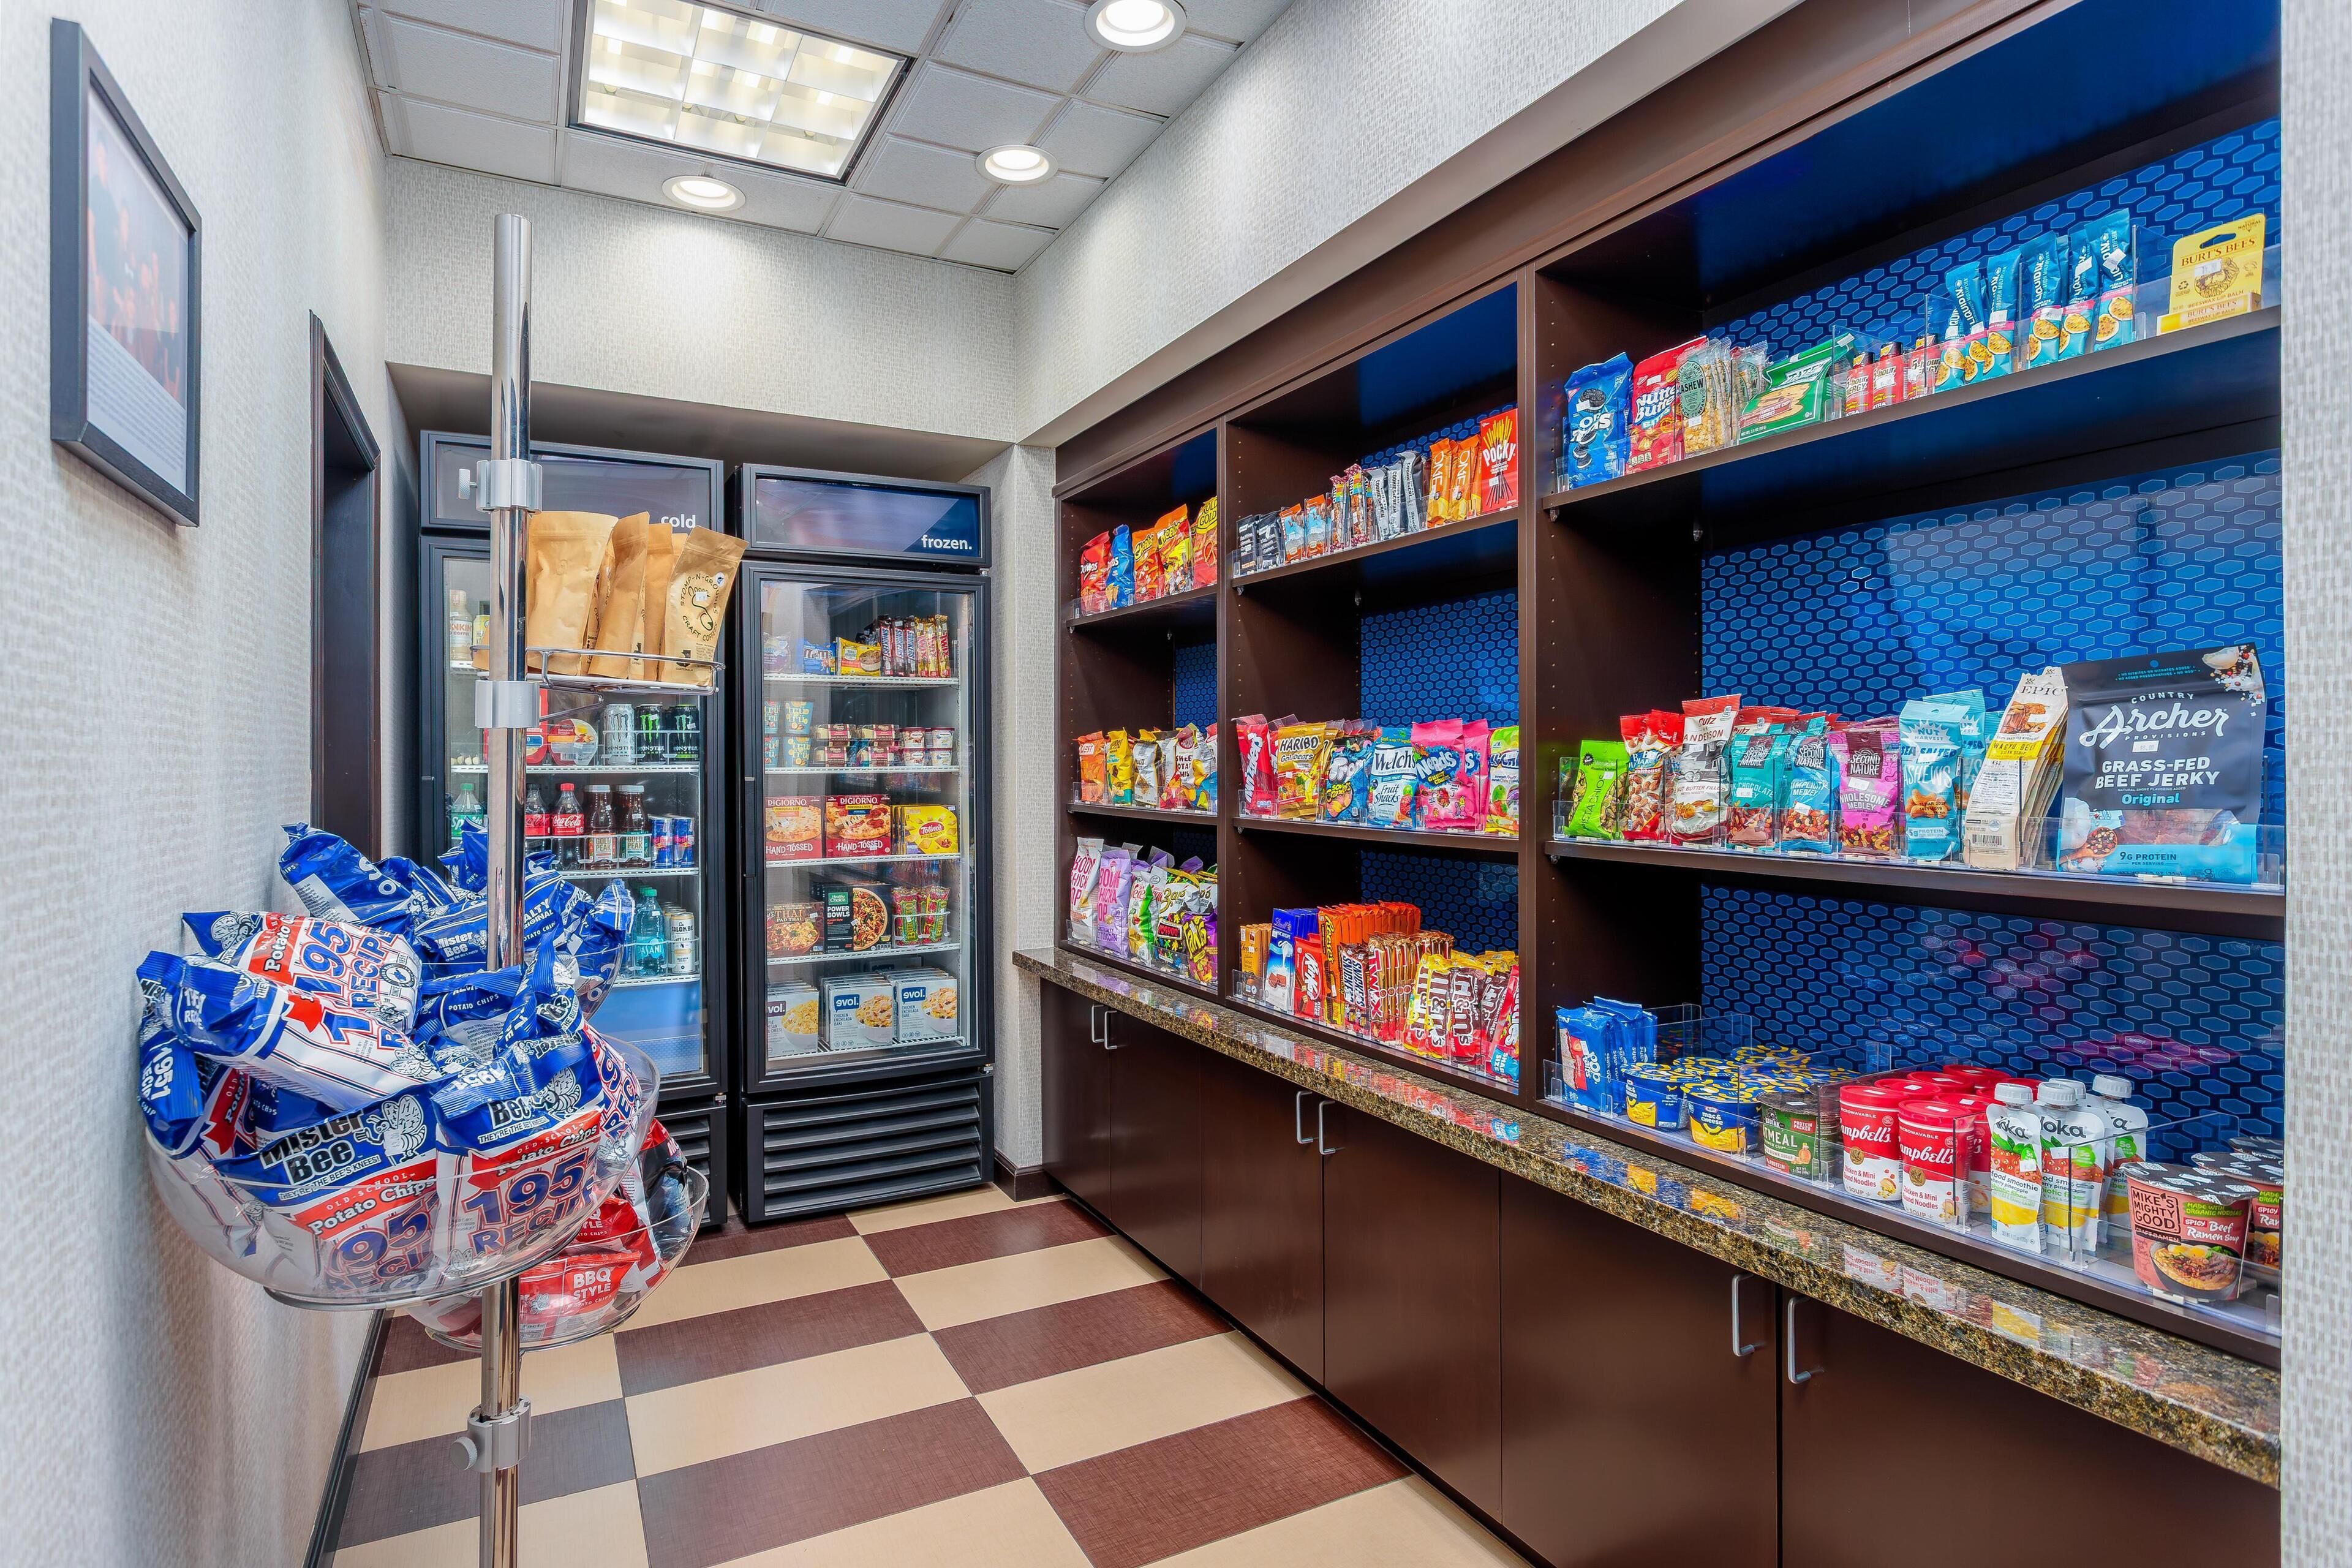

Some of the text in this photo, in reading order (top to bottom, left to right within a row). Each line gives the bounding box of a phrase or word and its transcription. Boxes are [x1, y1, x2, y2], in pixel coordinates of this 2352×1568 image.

[2237, 220, 2261, 230] NATURAL
[2180, 238, 2256, 267] BURT'S BEES
[2188, 298, 2215, 309] BEESWAX
[2227, 290, 2244, 298] BALM
[2187, 300, 2237, 318] BURT'S BEES
[2187, 315, 2212, 323] BEESWAX
[1761, 404, 1781, 415] CHOCOLATE
[1761, 410, 1776, 419] COOKIES
[1482, 439, 1517, 467] POCKY
[1431, 450, 1444, 486] ONE
[1456, 450, 1471, 486] ONE
[661, 514, 696, 529] cold
[1199, 510, 1217, 526] GOLD
[921, 535, 972, 551] frozen.
[682, 615, 701, 639] CRAFT
[881, 627, 891, 657] SNICKERS
[894, 627, 903, 658] SNICKERS
[906, 628, 914, 660] SNICKERS
[2021, 685, 2065, 696] EPIC
[2131, 692, 2195, 704] COUNTRY
[1918, 727, 1940, 736] NUT
[2079, 702, 2230, 749] Archer
[1684, 729, 1724, 741] ANDERSON
[2125, 730, 2206, 741] PROVISIONS
[1280, 735, 1321, 753] HARIBO
[1901, 745, 1958, 758] SEA SALTED
[1374, 749, 1416, 771] Welch's
[1740, 756, 1763, 766] NATURE
[1746, 749, 1769, 759] SECOND
[1798, 747, 1824, 759] SECOND
[1850, 754, 1880, 765] SECOND
[1796, 758, 1824, 769] NATURE
[1850, 764, 1880, 775] NATURE
[2101, 756, 2211, 774] GRASS-FED
[1904, 764, 1952, 788] ASHEWS
[2094, 771, 2220, 790] BEEF JERKY
[1381, 784, 1400, 794] Fruit
[1374, 793, 1400, 805] Snacks
[1839, 792, 1890, 809] WHOLESOME
[1847, 801, 1877, 811] MEDLEY
[2121, 793, 2180, 807] Original
[553, 814, 581, 827] Coca-Cola
[920, 823, 943, 833] Totino's
[766, 842, 813, 854] HAND-TOSSED
[2119, 851, 2133, 861] 9G
[1274, 917, 1287, 930] Lindt
[434, 930, 474, 950] Mister
[1324, 914, 1335, 964] Reese's
[264, 924, 292, 973] Potato
[443, 943, 469, 959] Bee
[637, 944, 662, 956] DASANI
[1352, 960, 1365, 1008] SNICKERS
[448, 993, 500, 1011] POTATO CHIPS
[835, 996, 859, 1006] evol.
[903, 989, 925, 999] evol.
[148, 1046, 174, 1101] 1951
[1582, 1054, 1591, 1079] tarts
[478, 1123, 523, 1144] THEY'RE THE
[559, 1123, 598, 1149] Chips
[283, 1138, 356, 1186] Bee
[312, 1155, 381, 1190] THE BEE'S KNEES!
[1863, 1171, 1876, 1180] Mini
[1853, 1176, 1877, 1188] Noodles
[2003, 1182, 2029, 1194] pineapple
[2007, 1175, 2039, 1192] smoothie
[307, 1175, 435, 1236] Potato Chips
[1915, 1198, 1939, 1210] Noodles
[1924, 1193, 1938, 1202] Mini
[2132, 1189, 2174, 1208] MIKE'S
[1909, 1208, 1926, 1217] SOUP
[2133, 1201, 2175, 1218] MIGHTY
[2185, 1208, 2217, 1216] ORGANIC
[2135, 1212, 2176, 1229] GOOD
[2208, 1220, 2234, 1233] Beef
[2187, 1226, 2239, 1244] Ramen Soup
[573, 1267, 612, 1289] BBQ
[573, 1283, 611, 1302] STYLE
[594, 1294, 612, 1303] CHIPS
